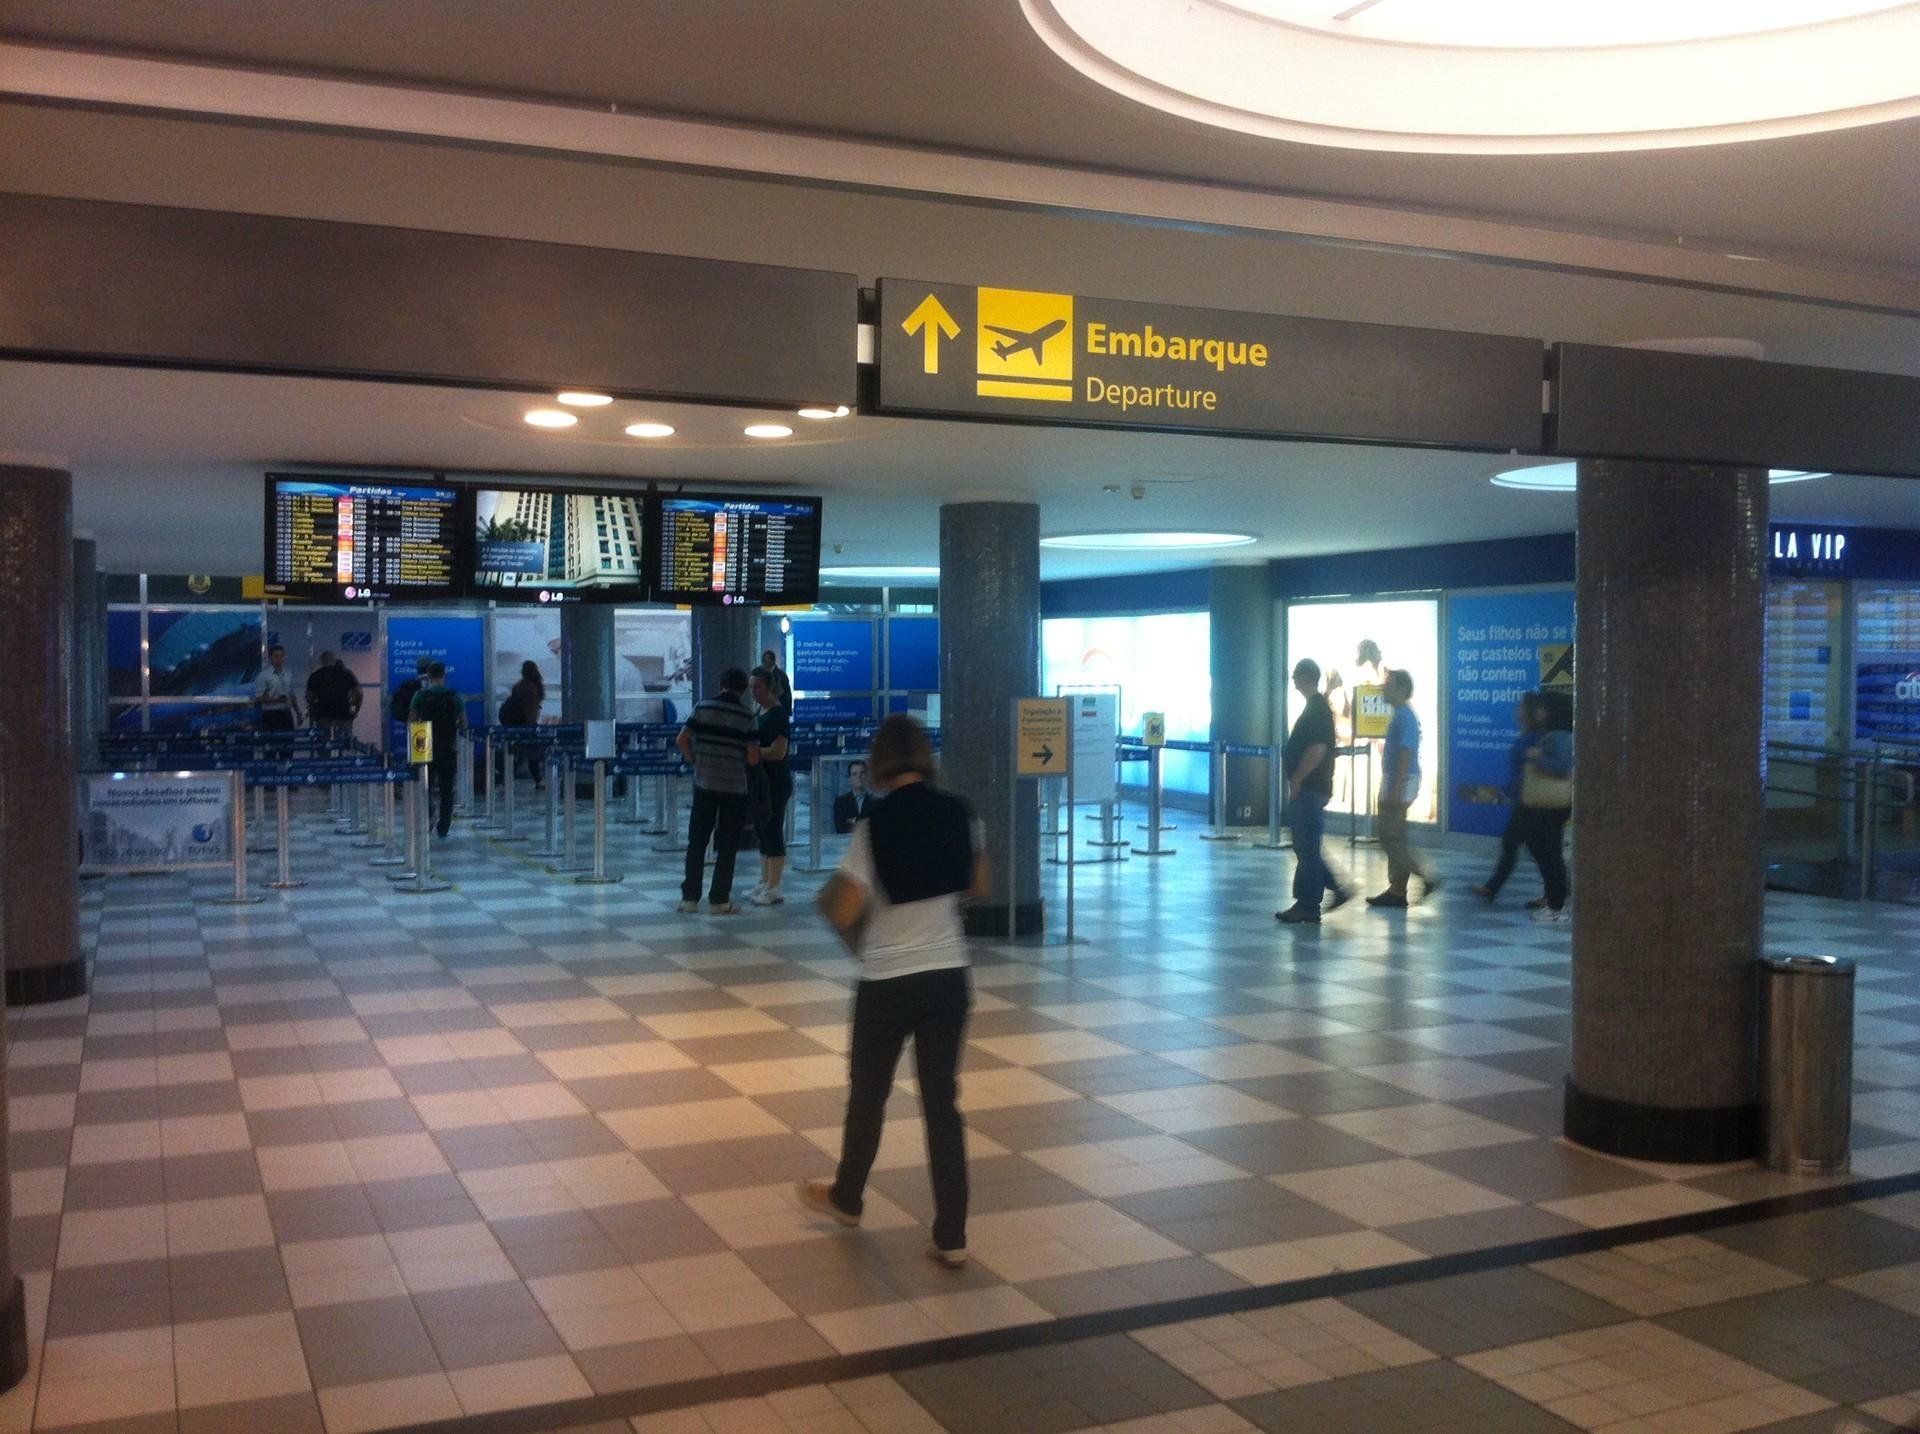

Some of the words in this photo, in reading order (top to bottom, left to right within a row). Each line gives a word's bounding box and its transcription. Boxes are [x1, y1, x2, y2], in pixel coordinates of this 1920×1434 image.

[1087, 322, 1269, 371] Embarque
[1086, 376, 1217, 411] Departure
[349, 486, 392, 496] Partidas
[723, 502, 760, 510] Partidas
[1774, 531, 1798, 558] LA
[1811, 533, 1846, 560] VIP
[358, 588, 370, 598] LG
[551, 592, 564, 602] LG
[734, 596, 744, 604] LG
[1457, 626, 1486, 642] Seus
[1489, 624, 1522, 640] filhos
[1526, 624, 1549, 640] não
[1552, 627, 1567, 640] se
[1457, 649, 1479, 664] que
[1481, 646, 1532, 661] castelos
[1457, 666, 1478, 681] não
[1481, 667, 1526, 681] contem
[1457, 688, 1489, 702] como
